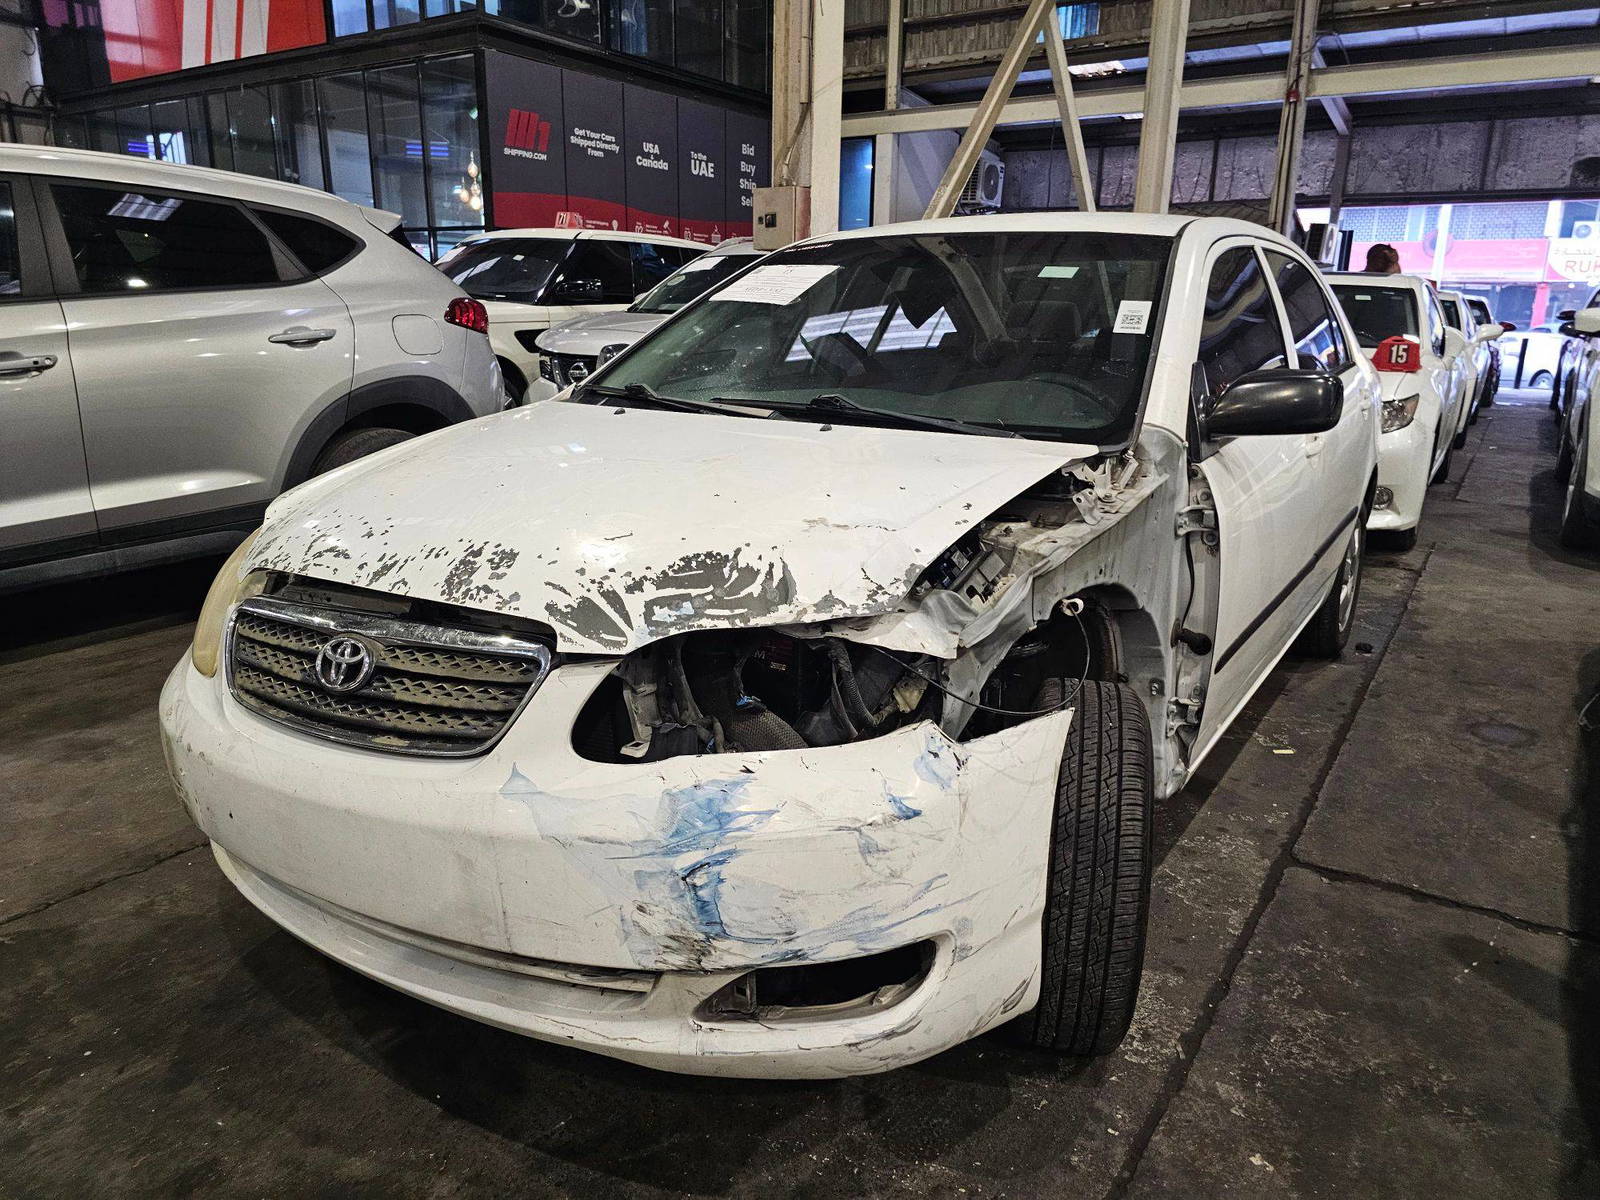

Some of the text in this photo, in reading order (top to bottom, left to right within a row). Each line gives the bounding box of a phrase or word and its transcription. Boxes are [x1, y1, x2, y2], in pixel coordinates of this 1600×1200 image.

[573, 127, 616, 143] Get Your Cars
[570, 136, 620, 154] Shipped Directly
[643, 142, 660, 155] USA
[742, 143, 755, 156] Bid
[504, 147, 547, 160] SHIPPING.COM
[587, 148, 604, 158] From
[690, 151, 707, 161] To the
[636, 155, 669, 171] Canada
[691, 159, 715, 178] UAE
[740, 161, 756, 176] Buy
[739, 178, 757, 190] Ship
[741, 195, 753, 207] Sel
[1390, 344, 1409, 364] 15
